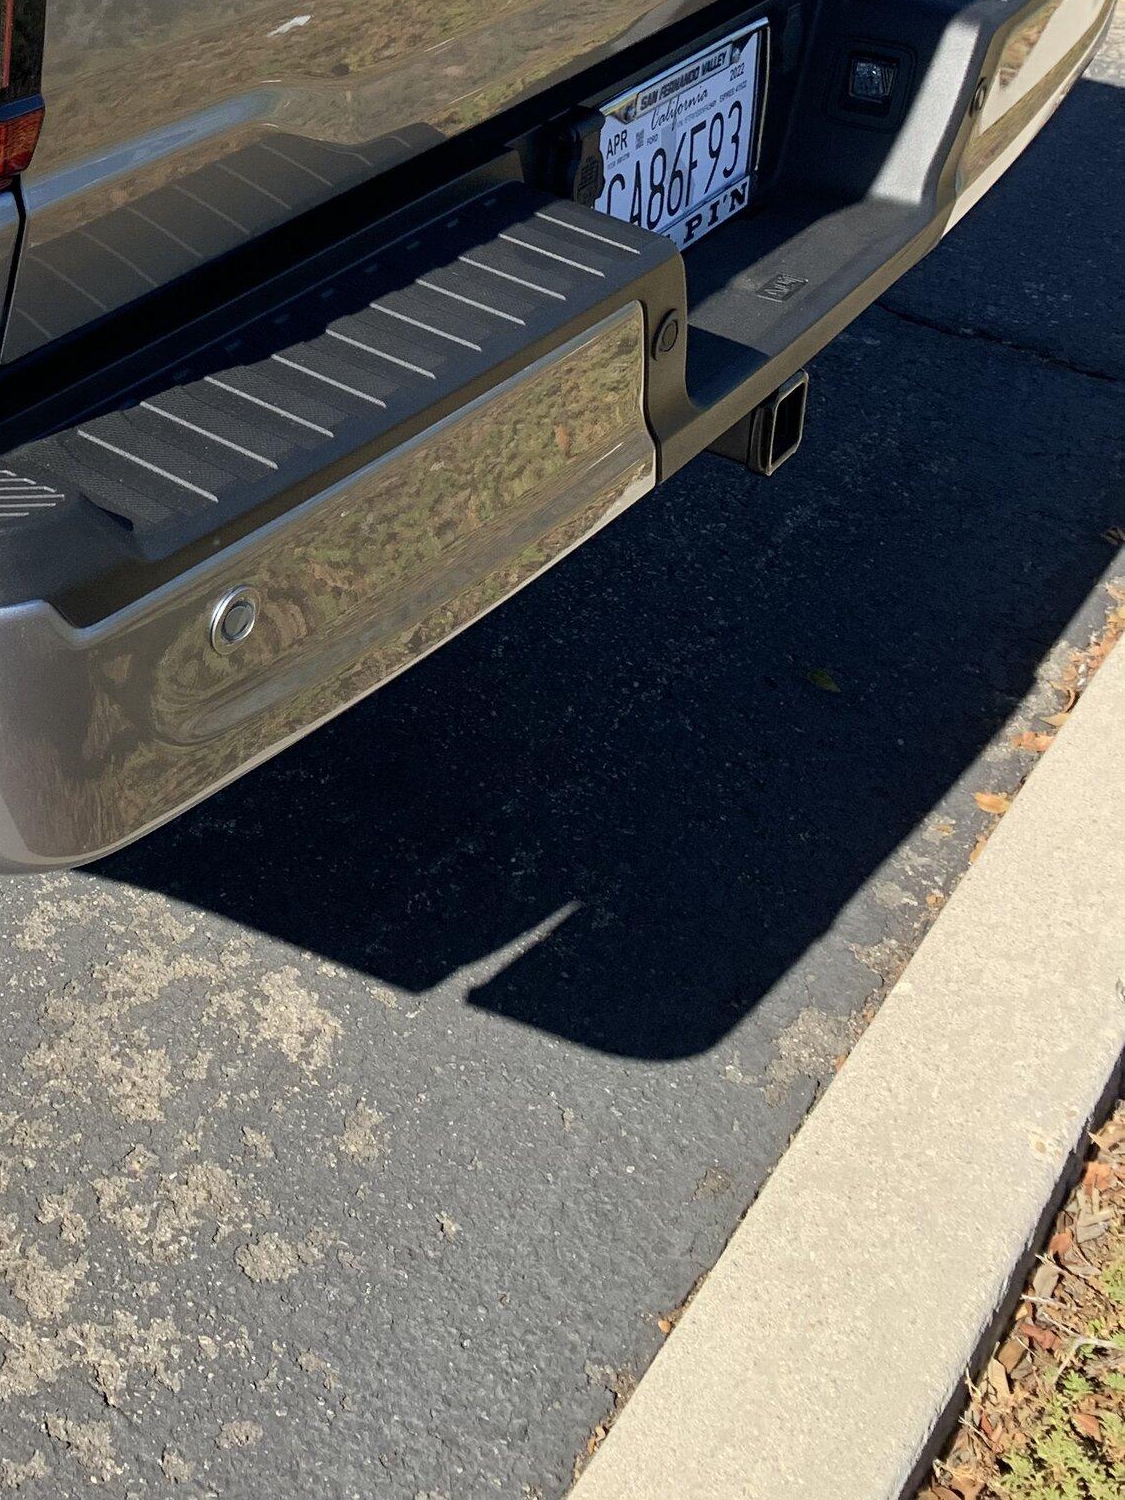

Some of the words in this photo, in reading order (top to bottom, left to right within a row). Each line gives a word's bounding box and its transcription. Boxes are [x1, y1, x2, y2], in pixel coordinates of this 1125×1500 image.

[640, 90, 658, 110] SAN
[701, 50, 727, 76] VALLEY
[651, 86, 708, 131] California
[606, 129, 627, 160] APR
[607, 100, 742, 230] CA86F93
